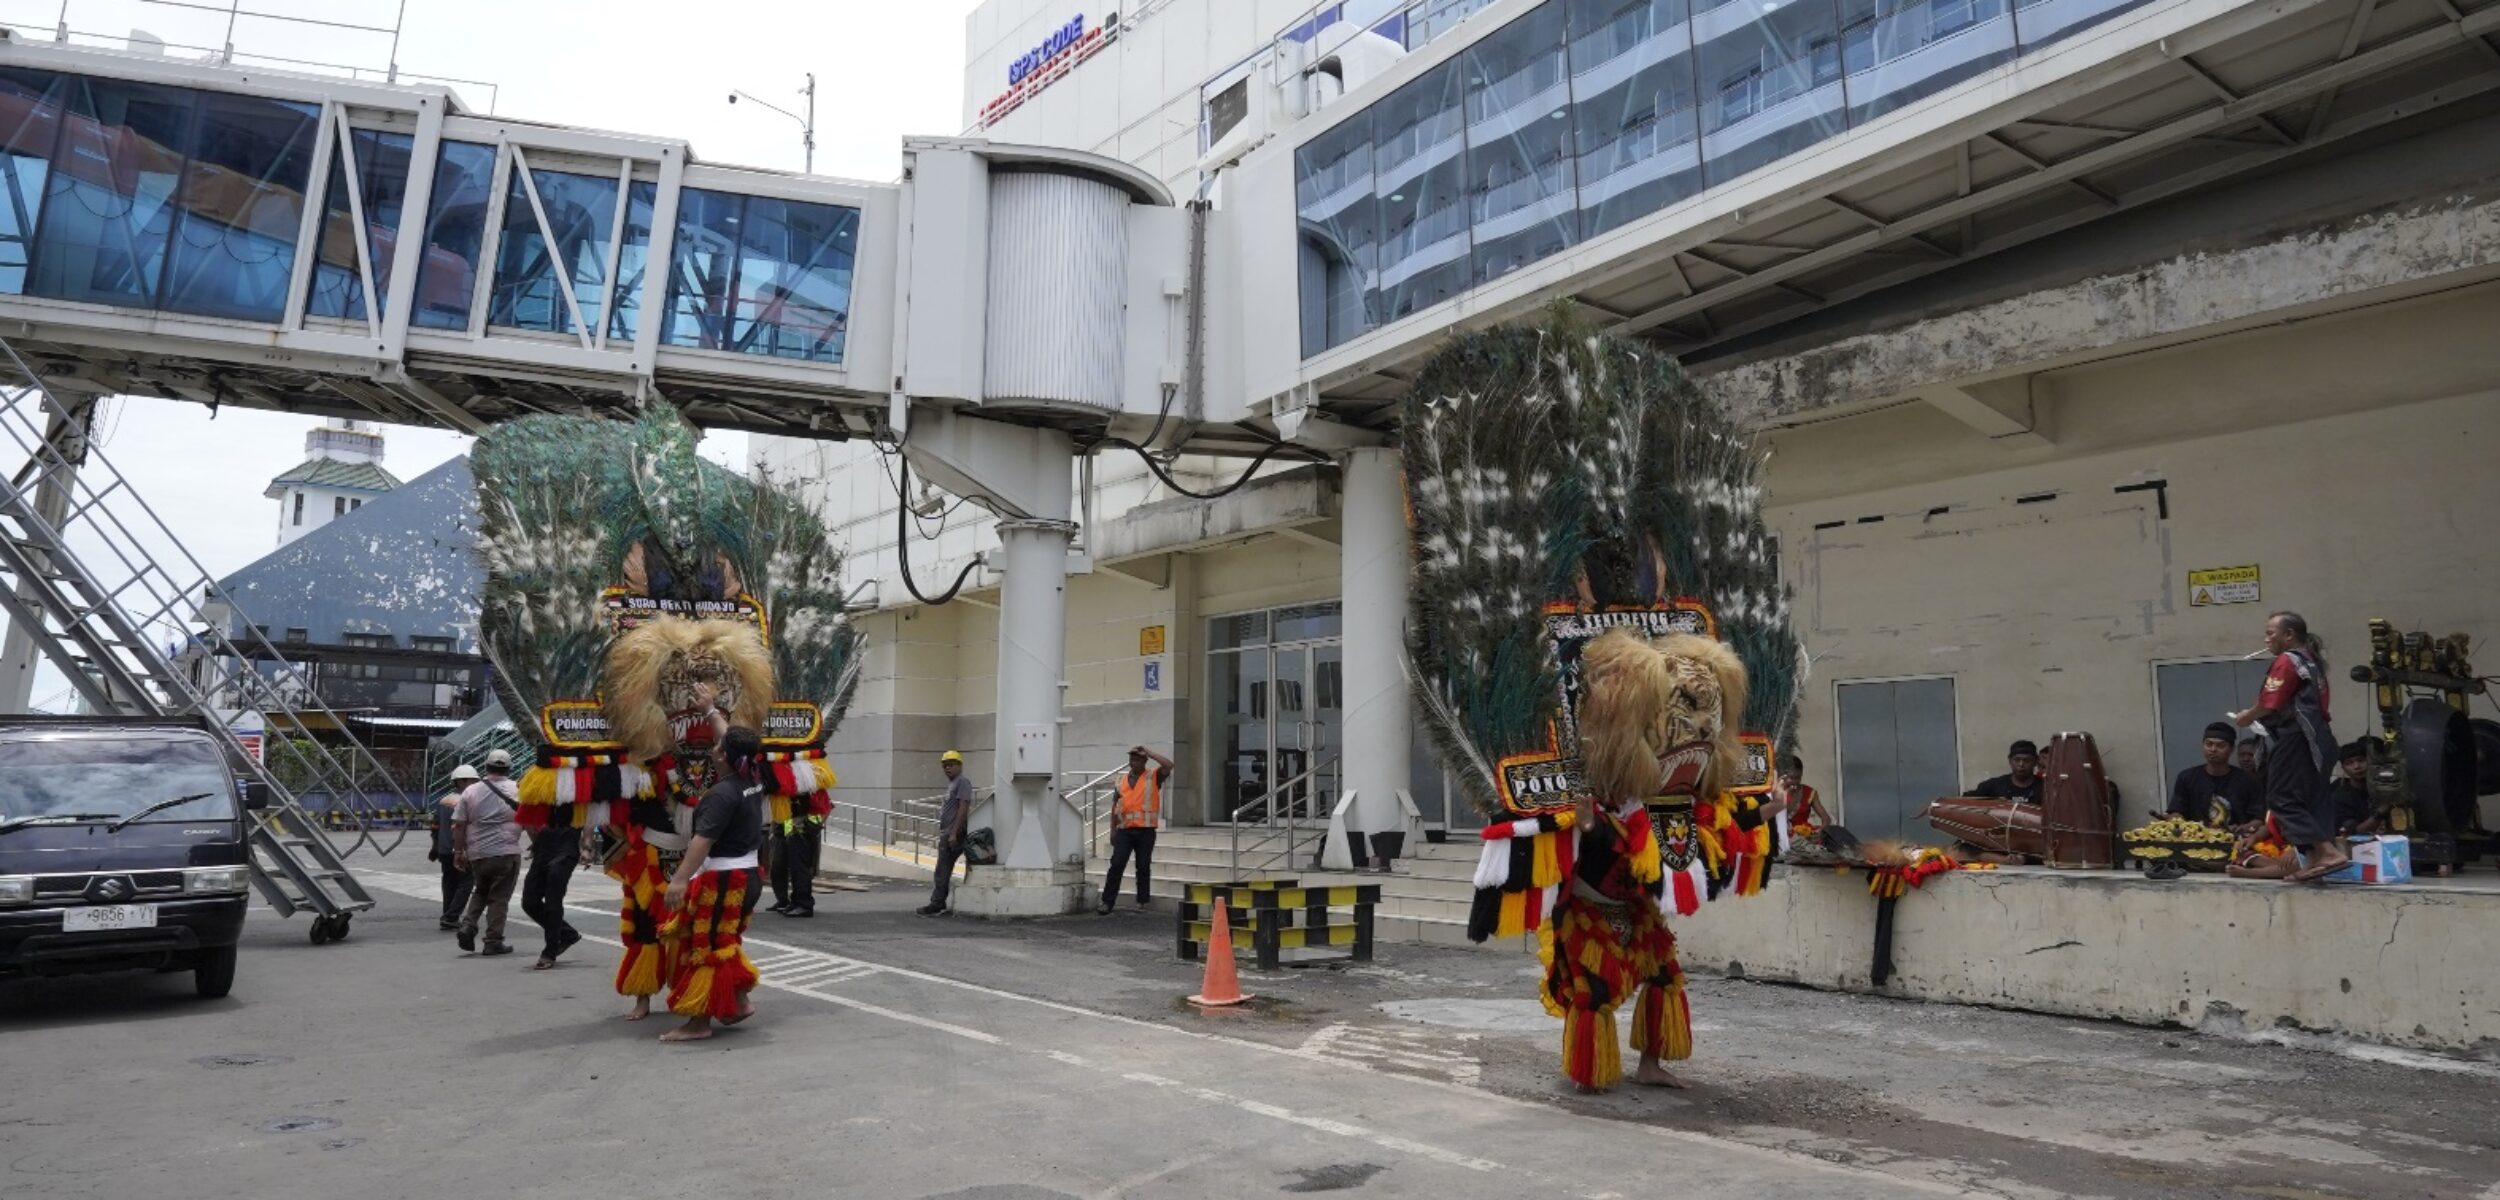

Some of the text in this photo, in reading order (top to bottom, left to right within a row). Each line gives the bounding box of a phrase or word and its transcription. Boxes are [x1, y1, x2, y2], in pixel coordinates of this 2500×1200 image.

[1008, 47, 1040, 86] ISPS
[1041, 12, 1084, 61] CODE
[762, 716, 811, 728] NDONESIA
